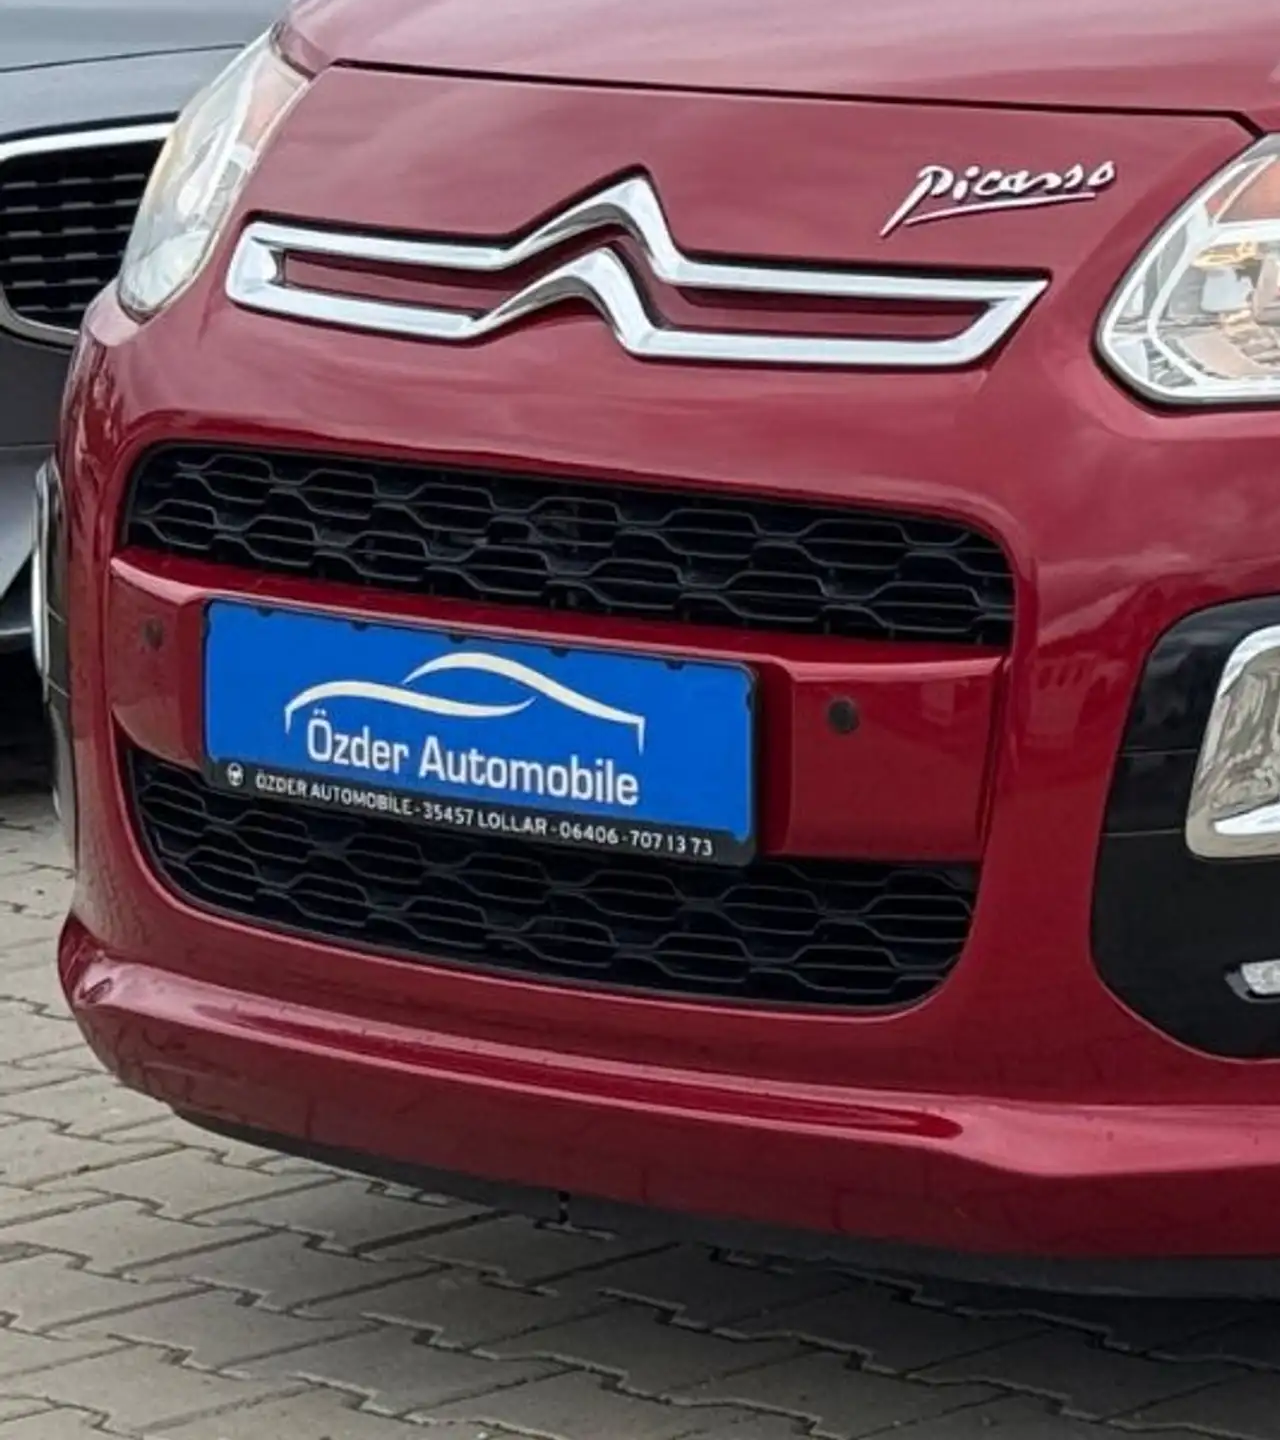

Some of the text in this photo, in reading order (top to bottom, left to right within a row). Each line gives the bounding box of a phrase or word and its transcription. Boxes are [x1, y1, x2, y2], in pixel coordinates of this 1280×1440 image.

[879, 160, 1115, 237] Picasso
[307, 708, 640, 806] Özder Automobile
[255, 769, 307, 798] ÖZDER
[423, 801, 475, 827] 35457
[477, 809, 548, 835] LOLLAR
[559, 822, 619, 845] 06406
